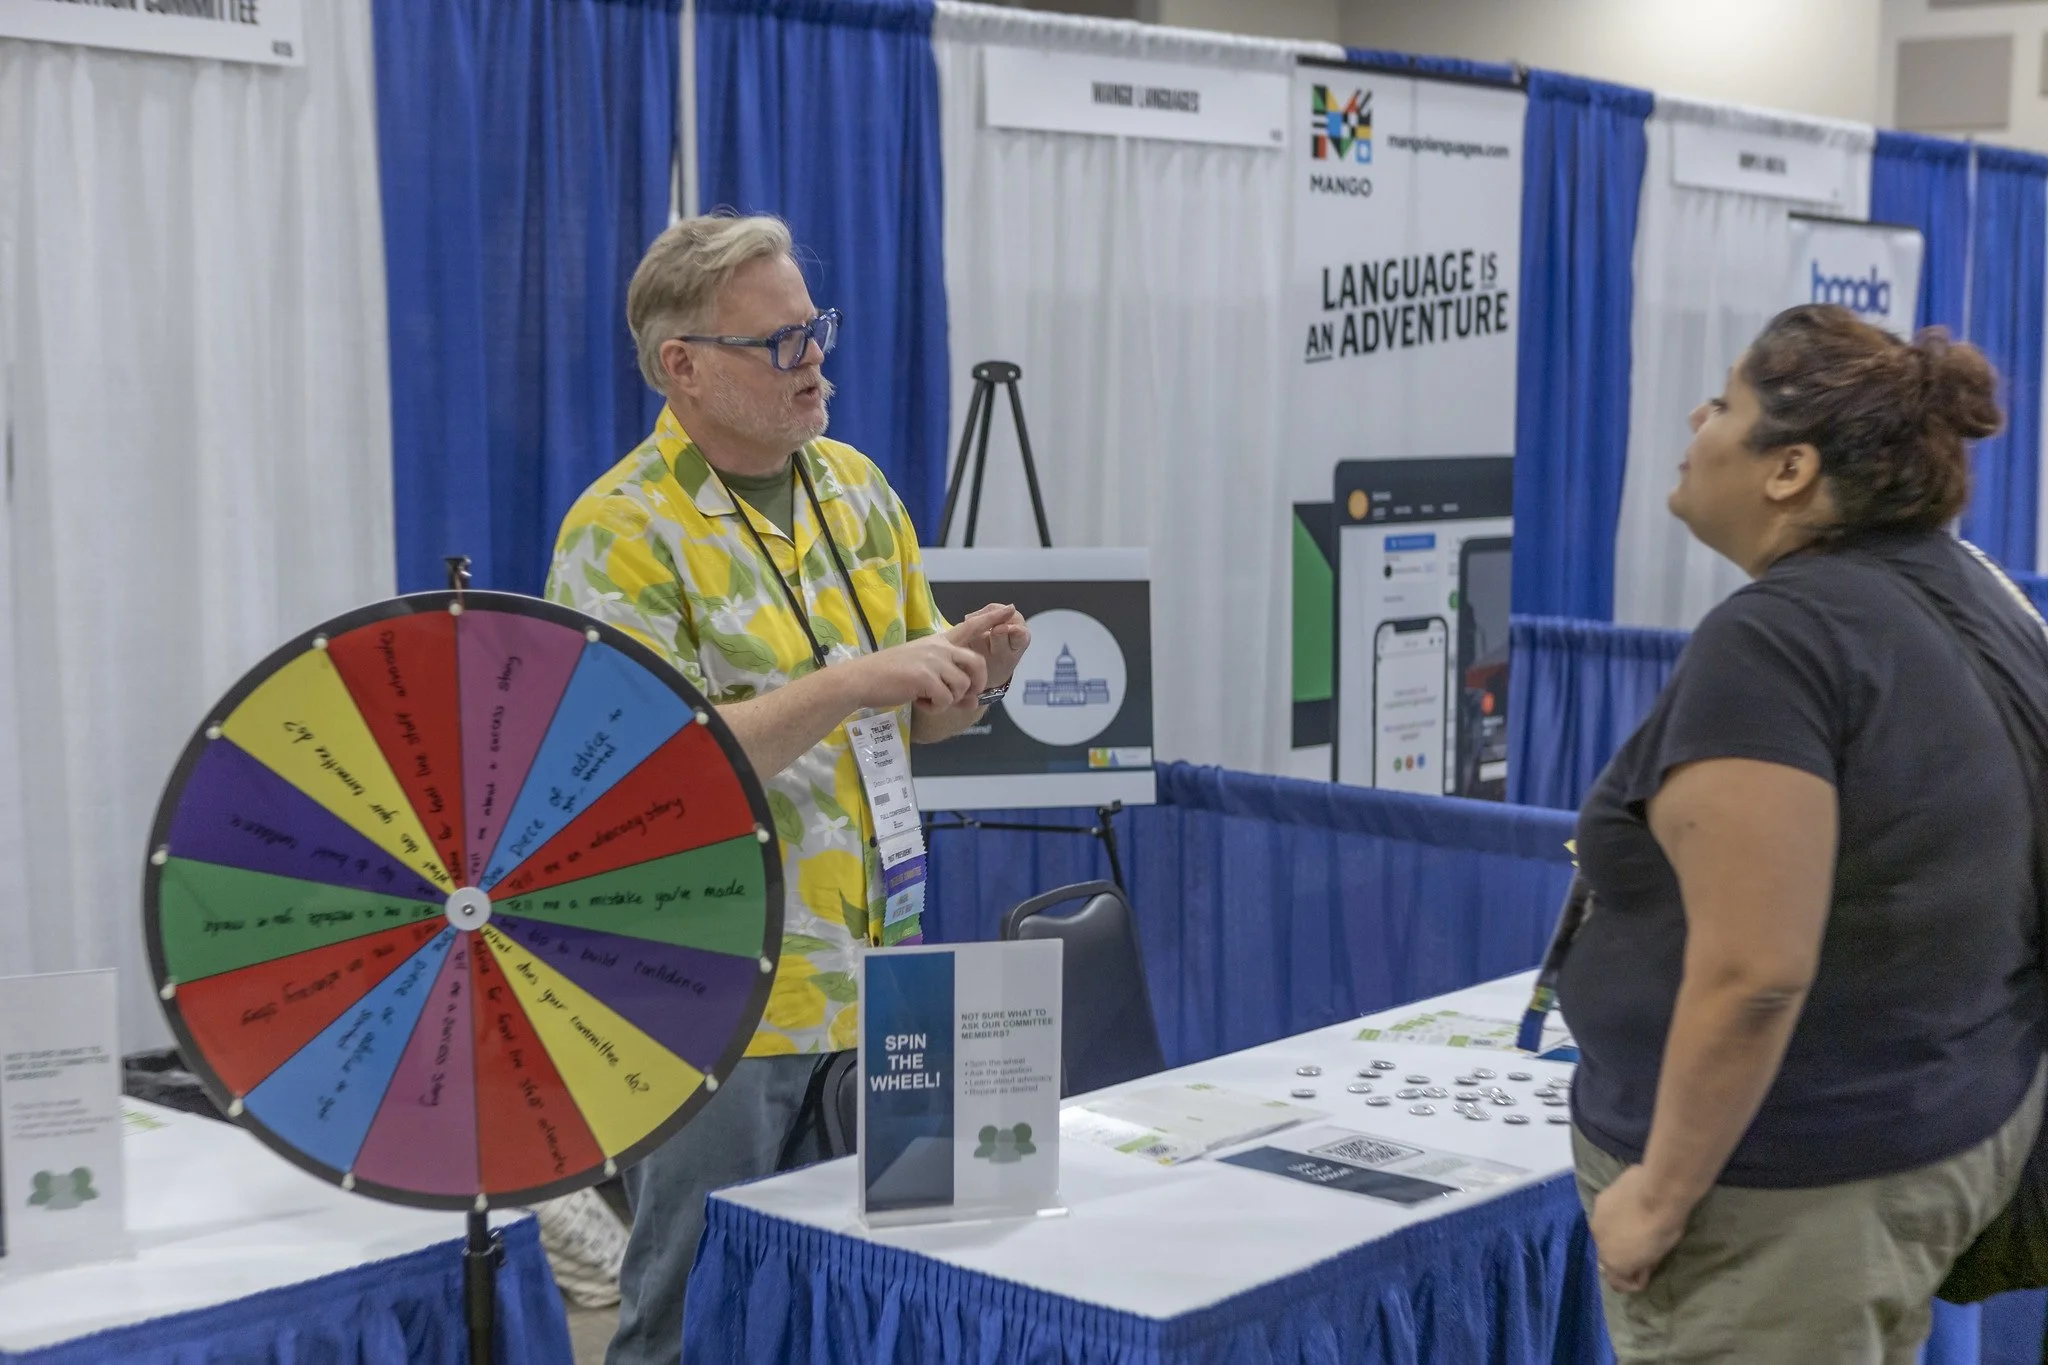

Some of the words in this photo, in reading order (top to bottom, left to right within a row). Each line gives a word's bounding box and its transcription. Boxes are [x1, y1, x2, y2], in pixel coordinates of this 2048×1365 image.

[1310, 173, 1373, 198] MANGO
[1322, 249, 1474, 311] LANGUAGE
[1481, 252, 1497, 282] IS
[1306, 323, 1333, 356] AN
[1340, 293, 1508, 357] ADVENTURE
[283, 721, 313, 743] do?
[483, 782, 495, 816] about
[490, 705, 505, 752] success
[498, 655, 522, 691] story
[315, 746, 363, 795] committee
[561, 795, 576, 813] get
[582, 743, 616, 781] started
[483, 867, 504, 887] One
[510, 819, 544, 857] piece
[549, 787, 563, 807] of
[572, 732, 609, 776] advice
[609, 708, 622, 722] to
[370, 804, 397, 824] your
[401, 833, 418, 853] does
[422, 861, 451, 883] What
[506, 899, 532, 911] Tell
[590, 892, 643, 906] mistake
[704, 879, 745, 898] made
[496, 914, 518, 932] One
[528, 928, 549, 946] tip
[557, 941, 569, 954] to
[580, 948, 619, 967] build
[634, 961, 706, 995] confidence
[481, 925, 512, 953] What
[516, 962, 537, 985] does
[537, 989, 566, 1009] your
[570, 1016, 618, 1065] committee
[624, 1072, 650, 1093] do?
[961, 1012, 979, 1021] NOT
[982, 1011, 1005, 1020] SURE
[1008, 1009, 1032, 1018] WHAT
[1035, 1008, 1046, 1016] TO
[961, 1022, 979, 1030] ASK
[982, 1021, 1000, 1029] OUR
[1003, 1018, 1053, 1028] COMMITTEE
[961, 1030, 1010, 1039] MEMBERS?
[885, 1033, 926, 1050] SPIN
[888, 1053, 923, 1070] THE
[1001, 1067, 1032, 1076] question
[1003, 1057, 1025, 1065] wheel
[870, 1072, 940, 1092] WHEEL!
[1010, 1085, 1038, 1093] desired
[1017, 1074, 1052, 1083] advocacy
